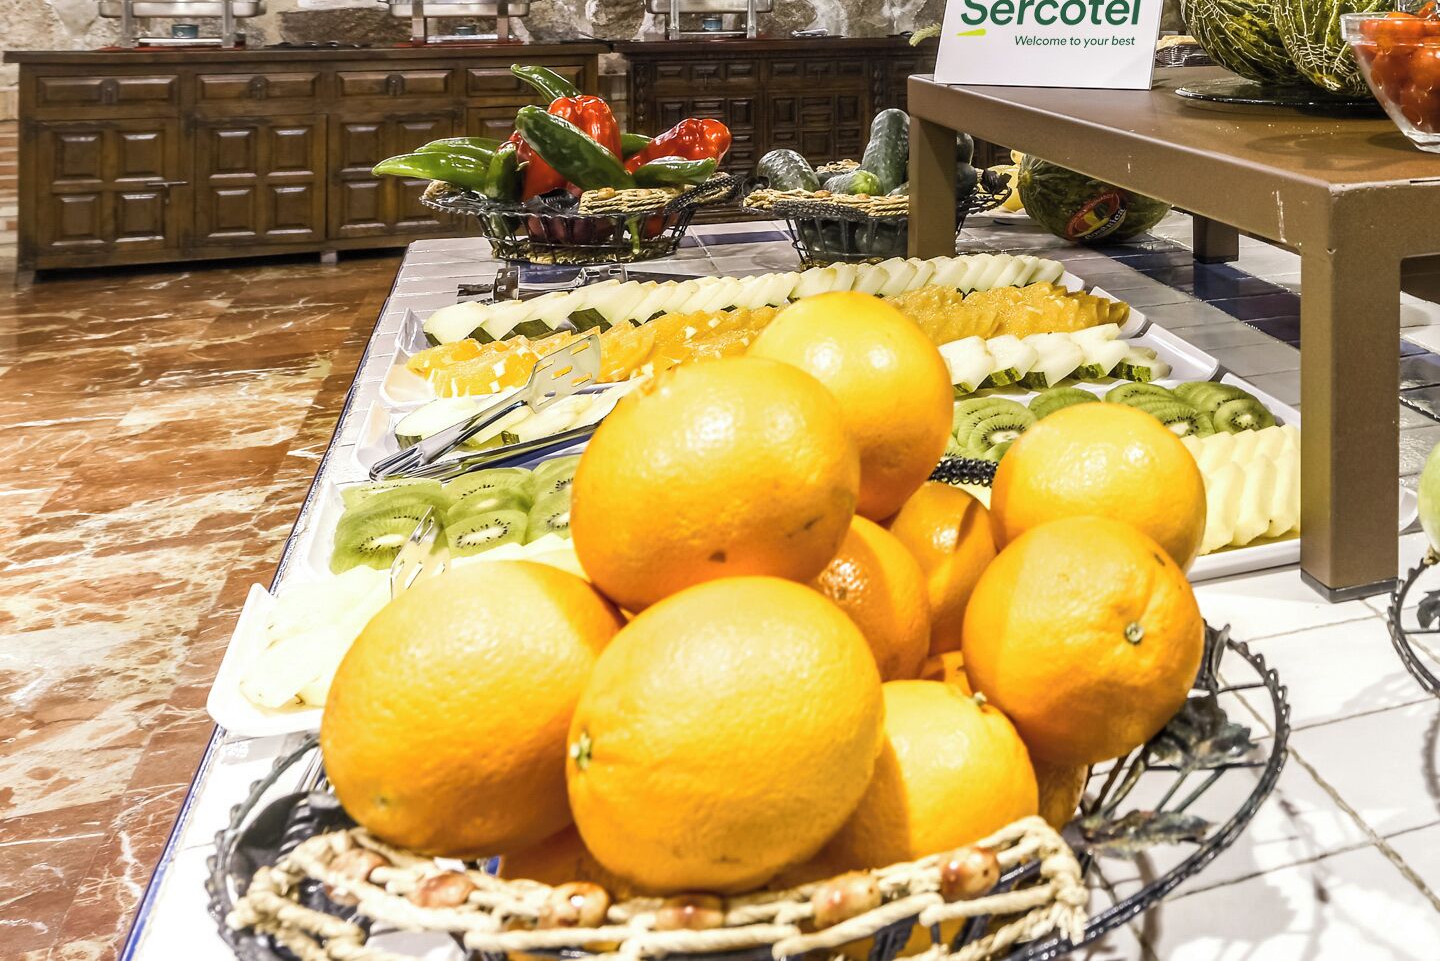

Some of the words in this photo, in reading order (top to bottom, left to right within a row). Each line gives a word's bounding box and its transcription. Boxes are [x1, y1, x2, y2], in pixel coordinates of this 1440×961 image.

[1014, 35, 1067, 46] Welcome
[1069, 36, 1082, 46] to
[1083, 38, 1110, 49] your
[1111, 35, 1136, 46] best
